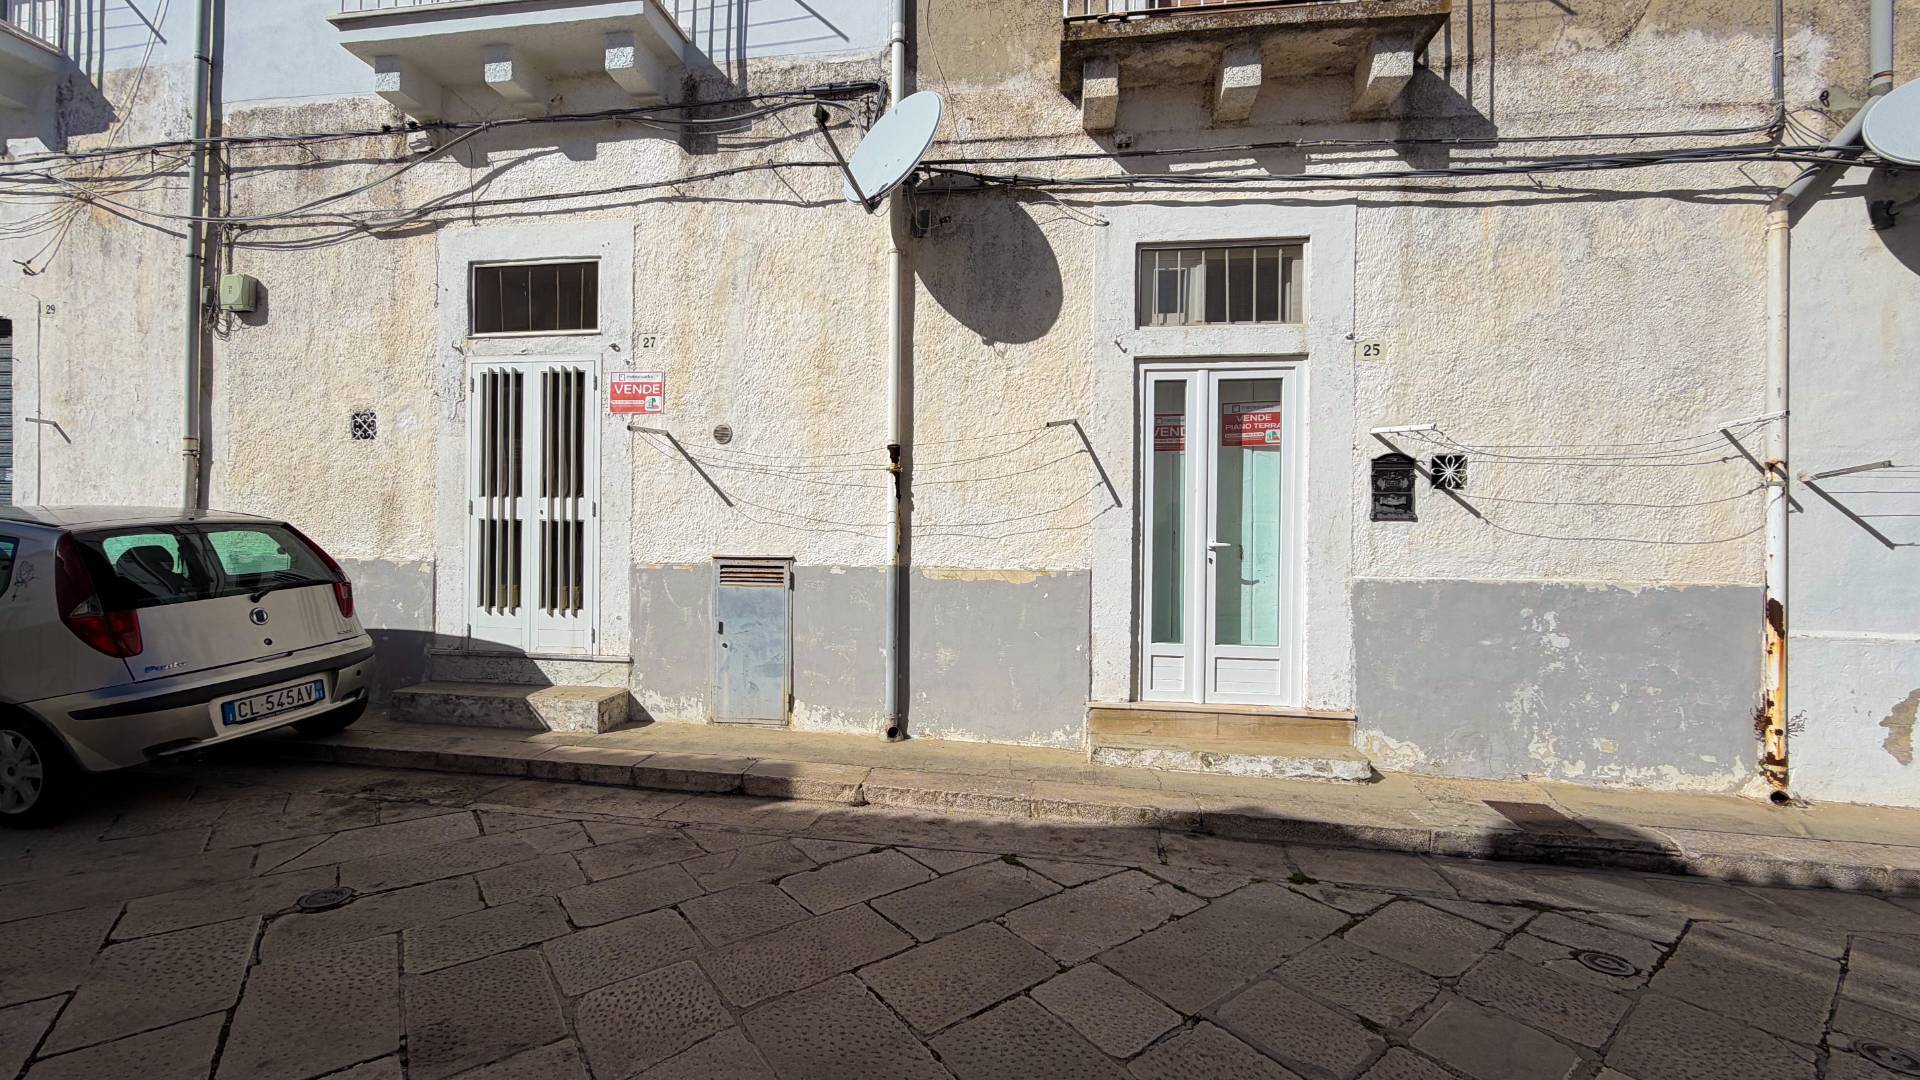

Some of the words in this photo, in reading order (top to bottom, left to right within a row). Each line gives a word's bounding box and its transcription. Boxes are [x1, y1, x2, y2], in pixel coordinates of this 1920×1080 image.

[46, 304, 55, 314] 29
[643, 337, 656, 348] 27
[1363, 344, 1380, 356] 25
[614, 384, 660, 394] VENDE
[1236, 413, 1272, 423] VENDE
[1225, 423, 1251, 431] PIANO
